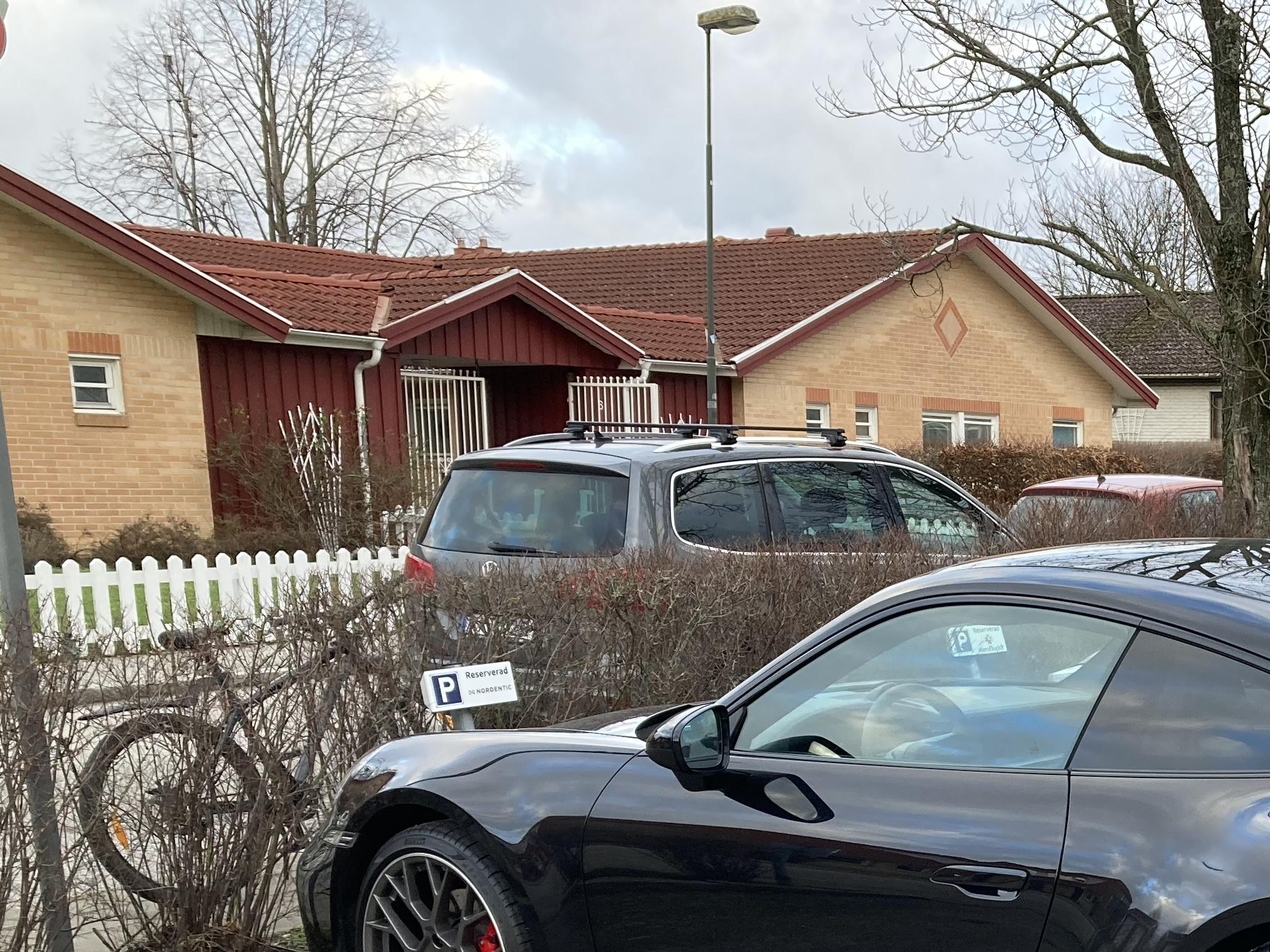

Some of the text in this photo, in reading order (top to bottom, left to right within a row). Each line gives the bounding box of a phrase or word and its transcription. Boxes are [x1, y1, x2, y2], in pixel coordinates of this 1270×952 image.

[465, 666, 509, 680] Reserverad
[437, 676, 455, 703] P
[476, 684, 512, 695] NORDENTIC
